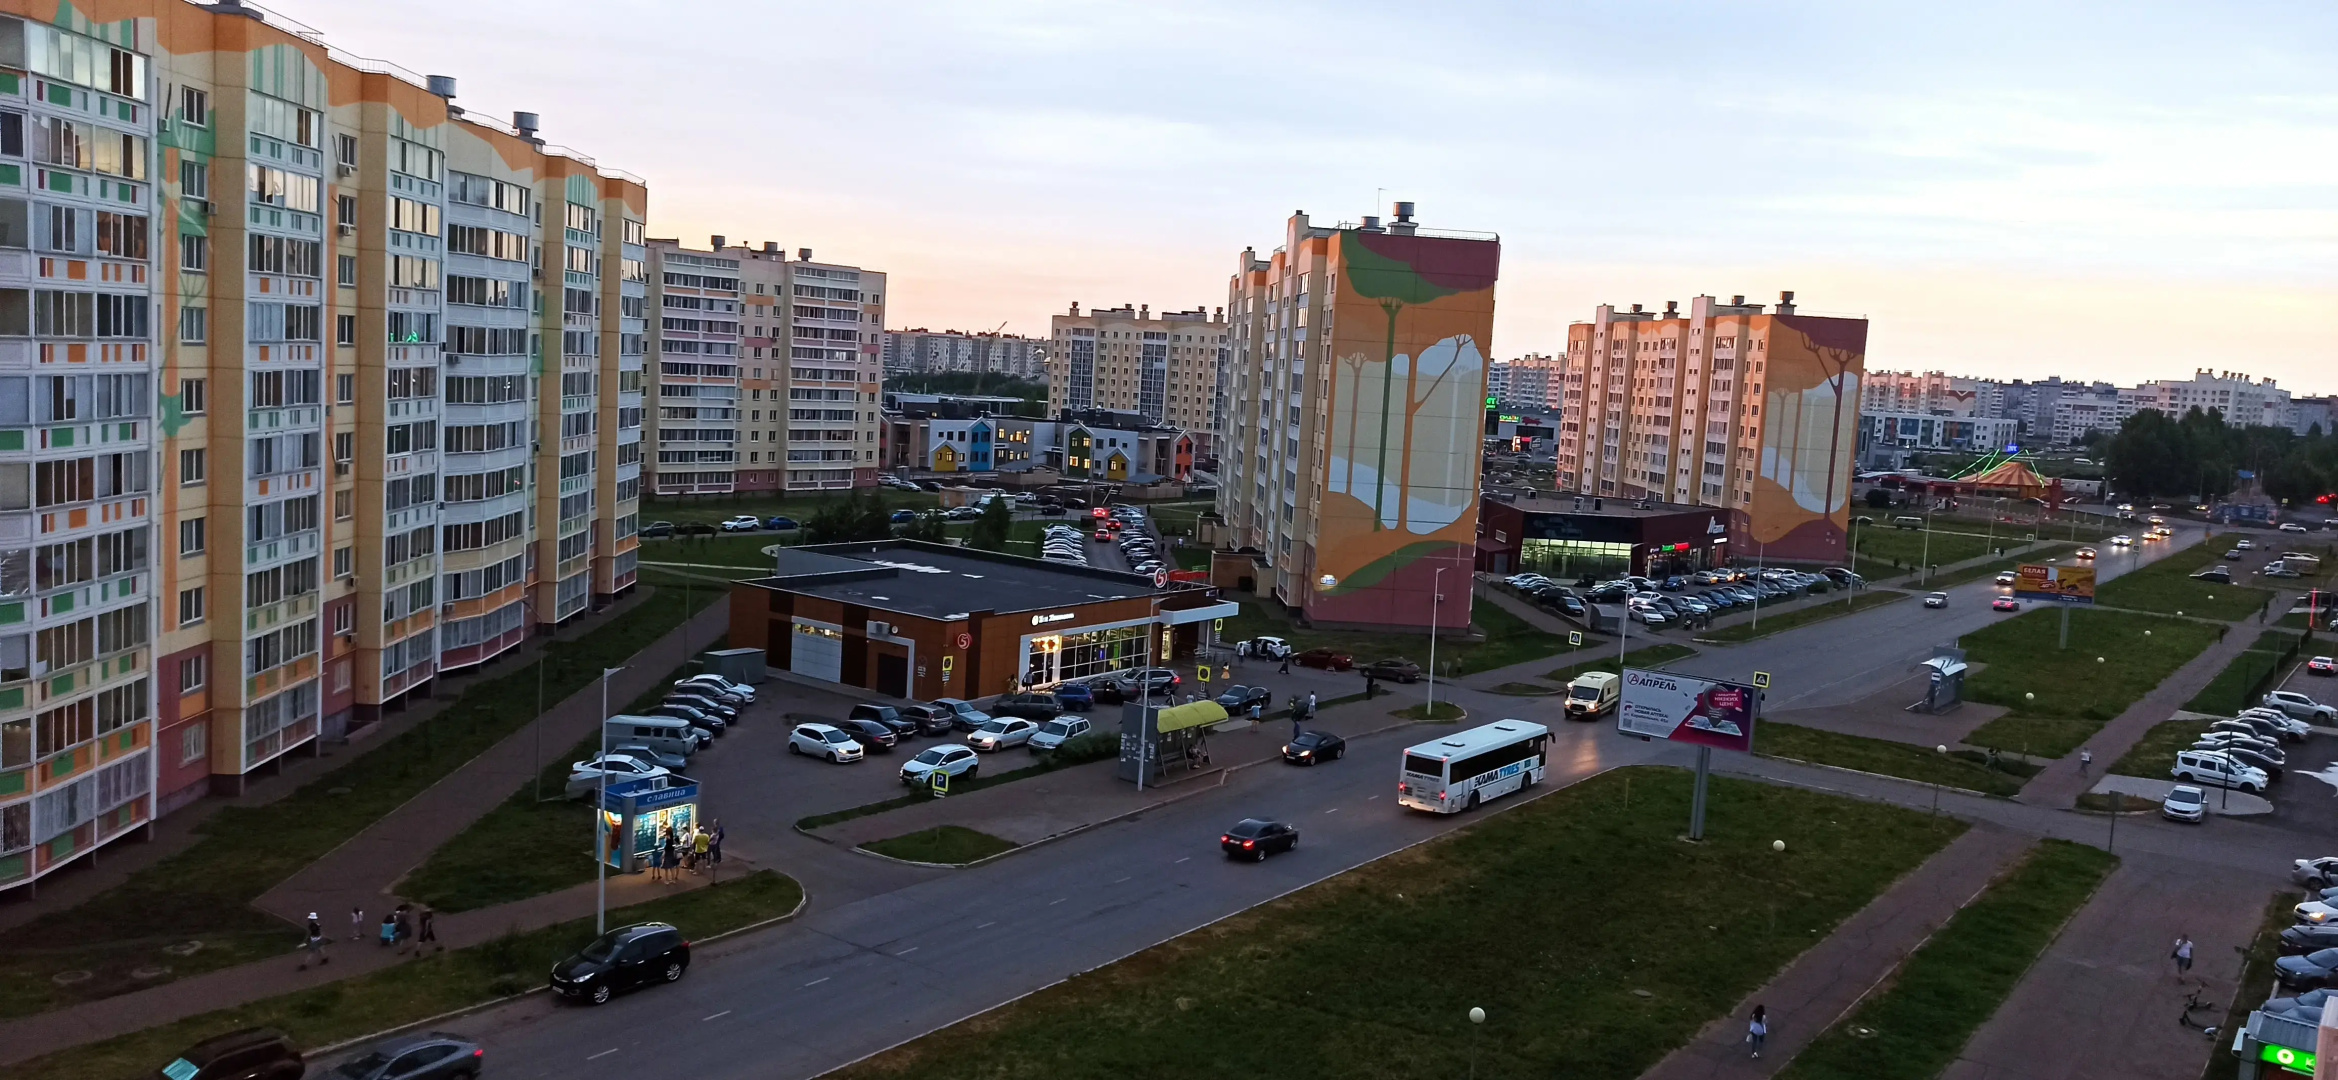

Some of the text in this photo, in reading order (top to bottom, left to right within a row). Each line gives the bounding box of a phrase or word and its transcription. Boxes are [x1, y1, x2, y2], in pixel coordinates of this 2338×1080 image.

[1639, 678, 1678, 691] АПРЕЛЬ
[1634, 704, 1662, 712] ОТКРЫЛАСЬ
[1499, 763, 1520, 778] TYRES
[936, 774, 944, 785] P
